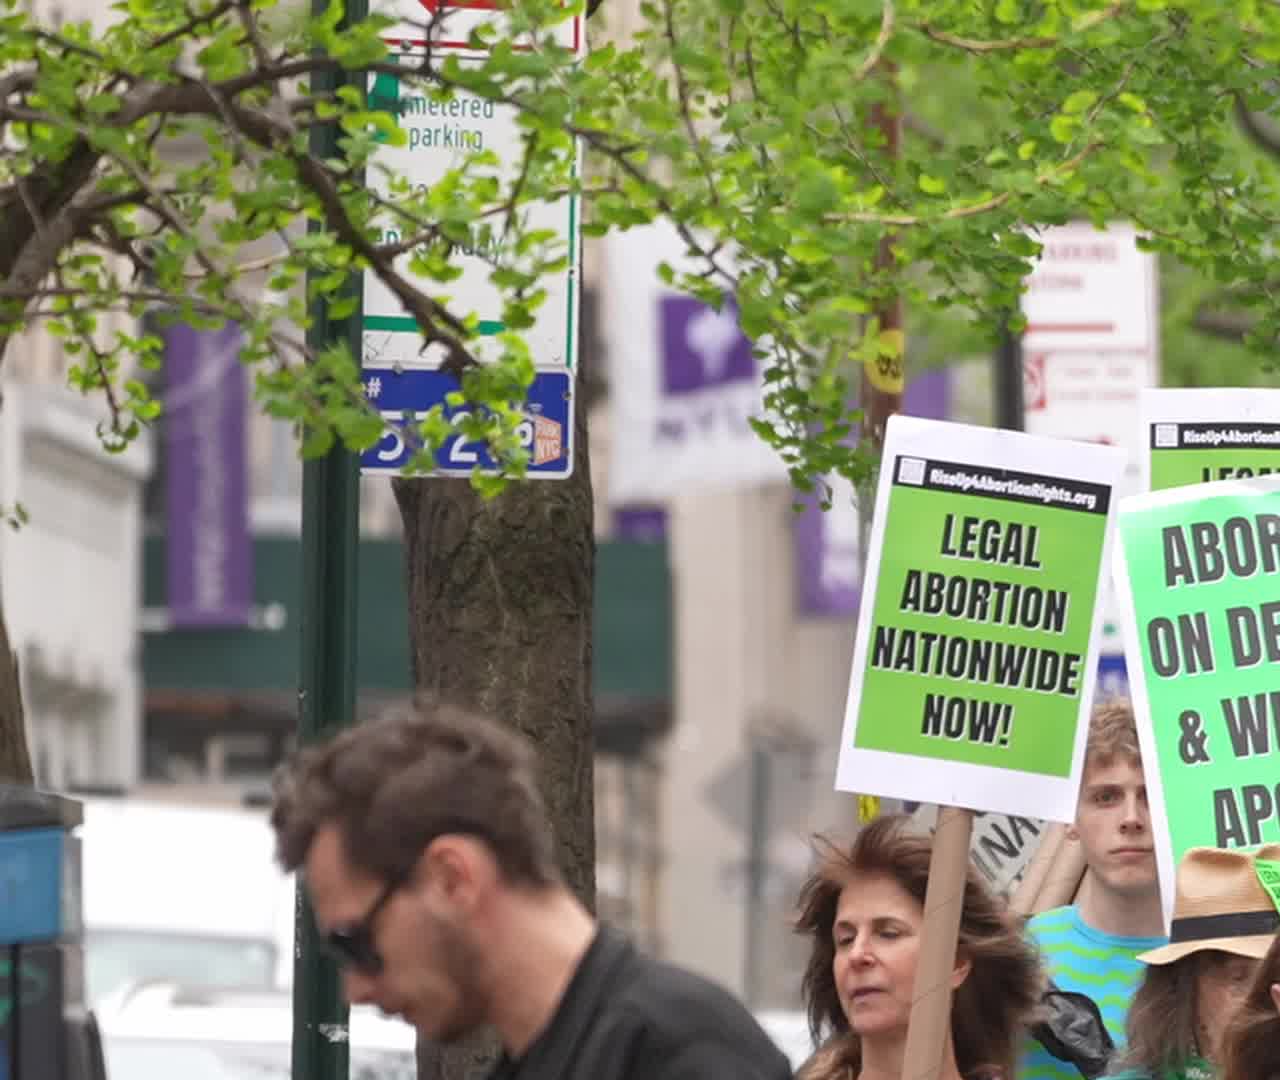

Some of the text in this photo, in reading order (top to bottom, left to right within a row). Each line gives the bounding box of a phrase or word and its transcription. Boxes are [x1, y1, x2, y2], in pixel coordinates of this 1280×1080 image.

[930, 469, 1097, 509] RiseUp4AbortionRights.org
[941, 513, 1041, 568] LEGAL
[900, 570, 1068, 633] ABORTION
[870, 626, 1081, 695] NATIONWIDE
[1148, 613, 1213, 677] ON
[921, 693, 1013, 747] NOW!
[1177, 709, 1210, 765] &
